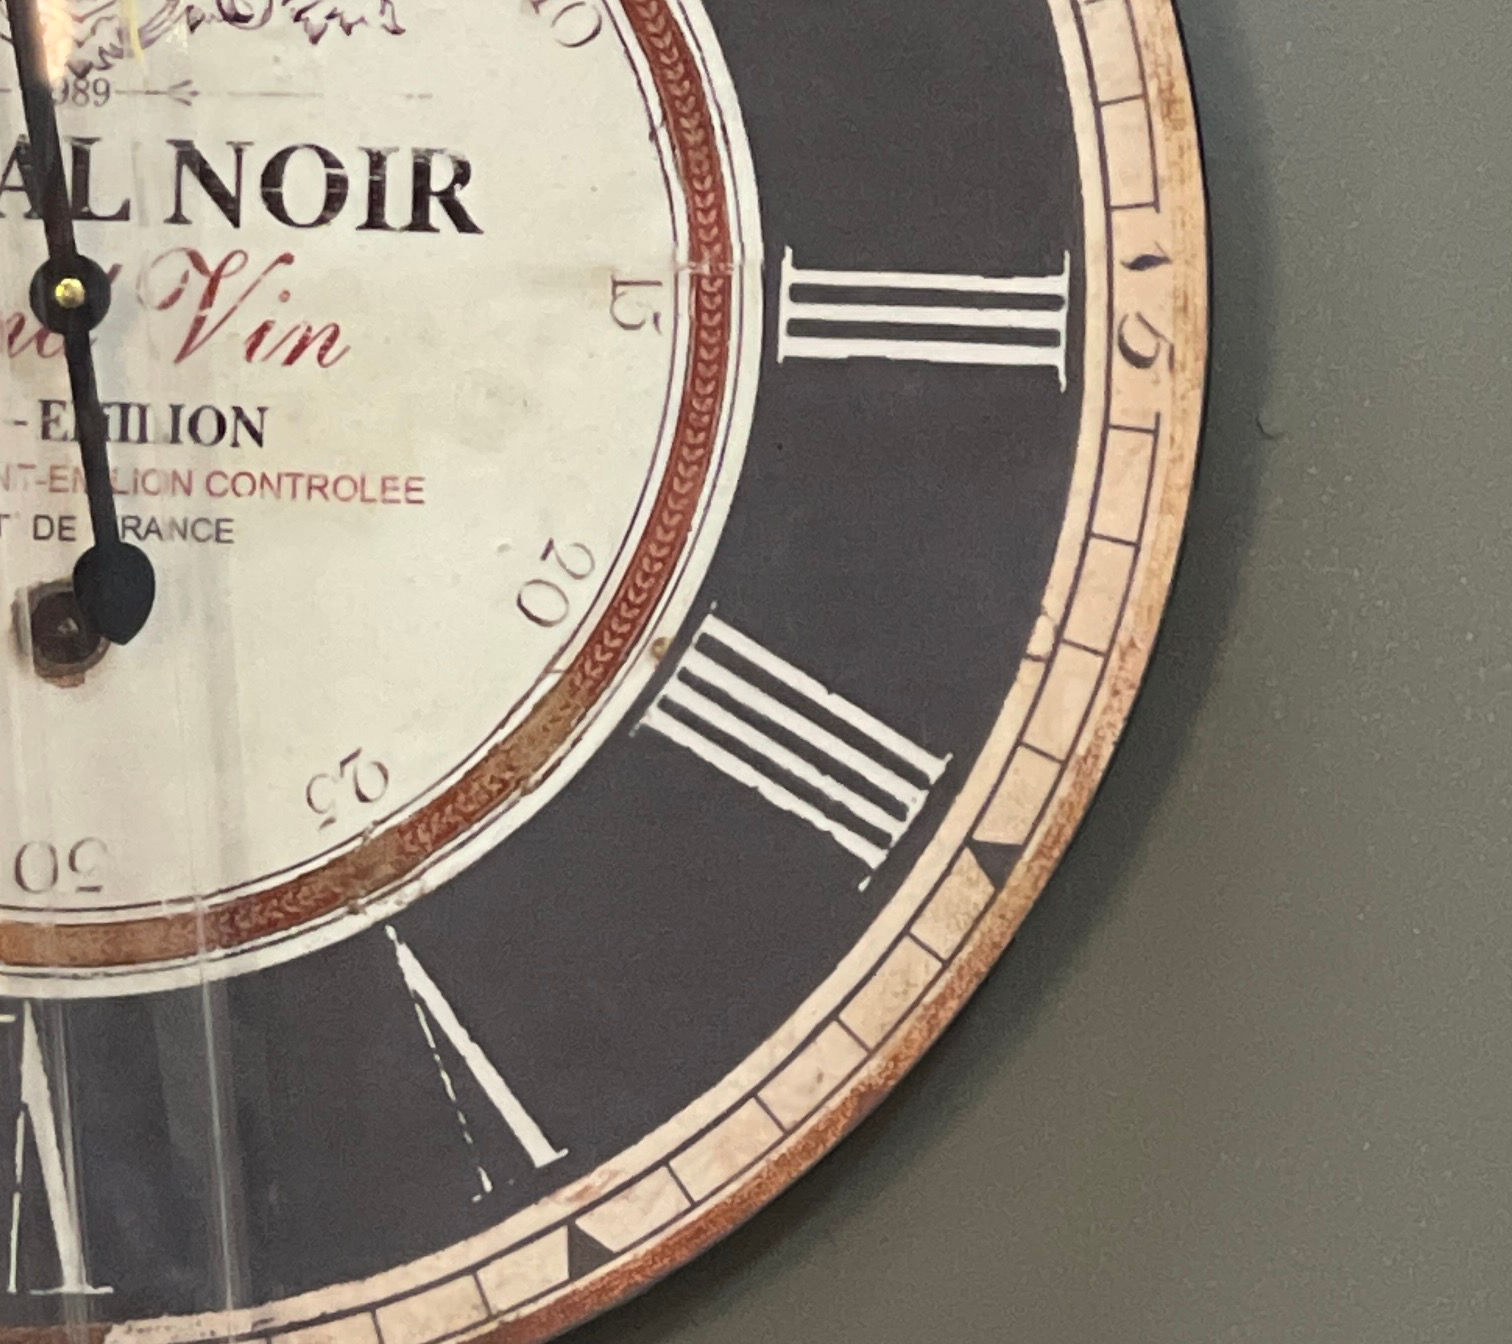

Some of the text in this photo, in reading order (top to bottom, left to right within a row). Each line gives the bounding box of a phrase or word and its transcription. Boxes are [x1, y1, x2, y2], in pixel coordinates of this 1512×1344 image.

[163, 139, 484, 236] NOIR
[136, 245, 353, 368] Vin
[610, 273, 662, 336] 15
[777, 245, 1070, 393] III
[1116, 240, 1175, 372] 15
[32, 513, 77, 542] DE
[121, 514, 235, 545] RANCE
[205, 468, 427, 506] CONTROLEE
[516, 537, 595, 627] 20
[305, 748, 390, 829] 25
[629, 601, 954, 892] IIII
[385, 923, 569, 1203] V
